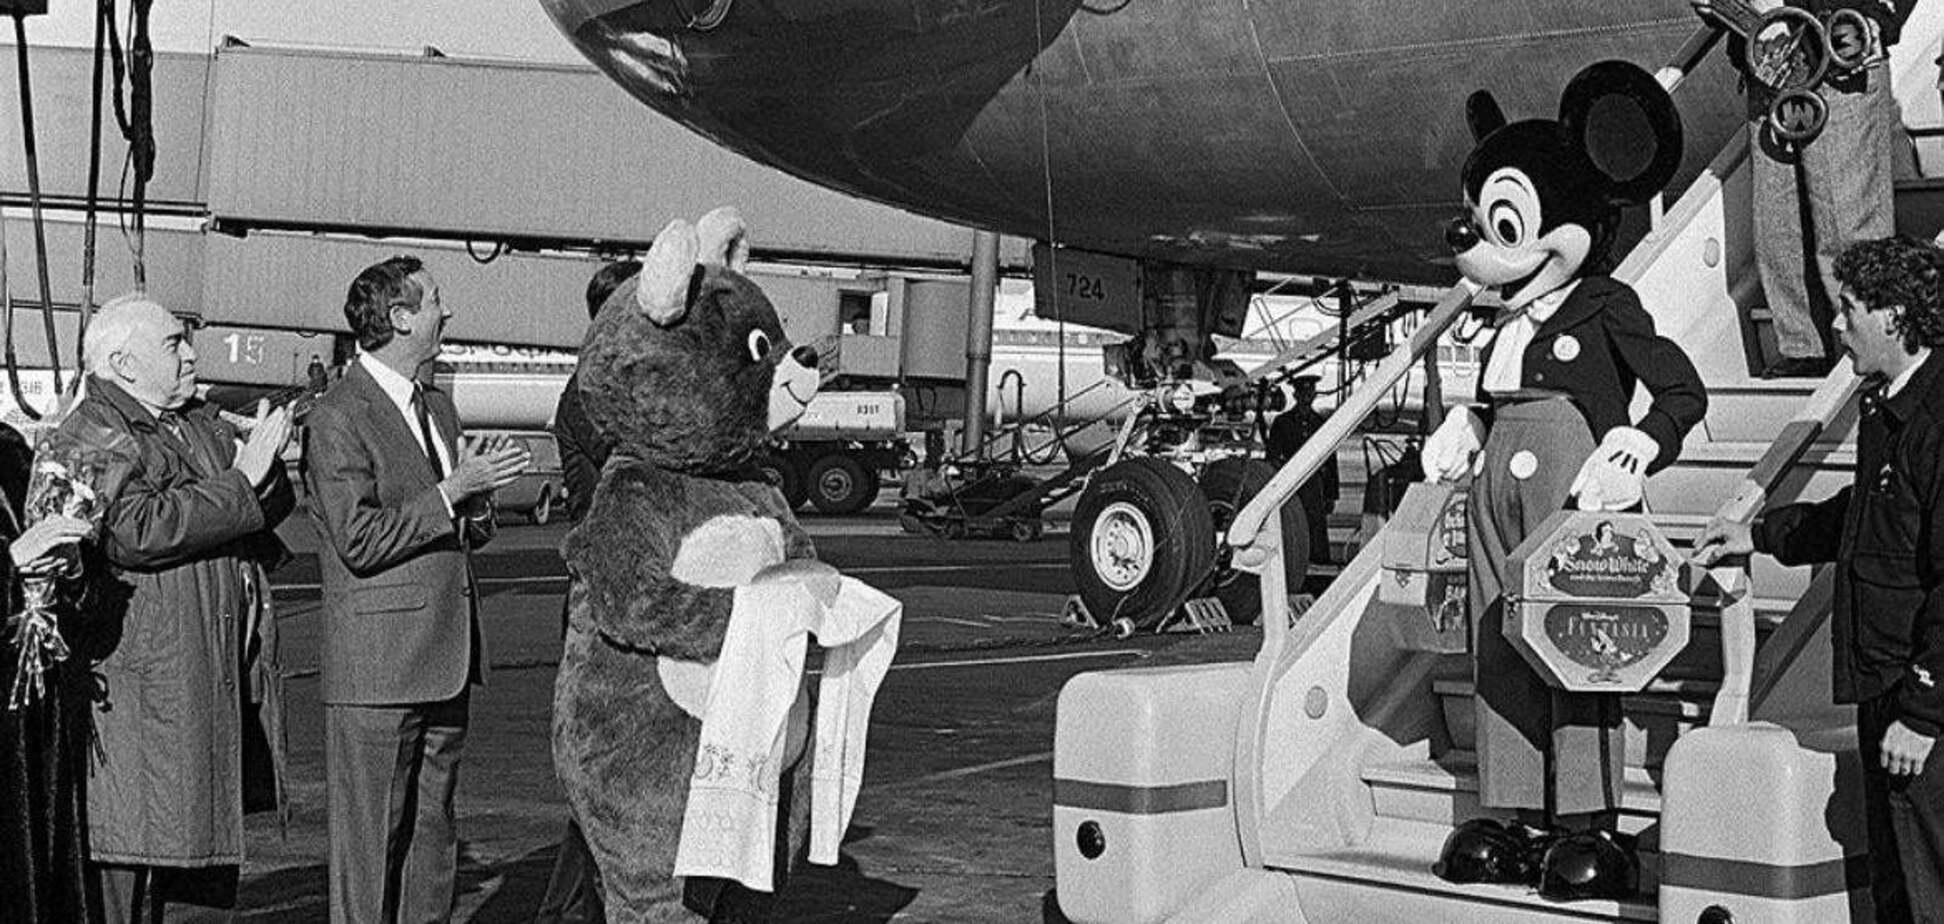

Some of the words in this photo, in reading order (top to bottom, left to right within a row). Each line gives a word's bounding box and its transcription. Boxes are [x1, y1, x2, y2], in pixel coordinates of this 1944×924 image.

[1066, 272, 1105, 300] 724
[223, 332, 265, 365] 15
[1563, 556, 1608, 572] Snow
[1609, 556, 1650, 574] White
